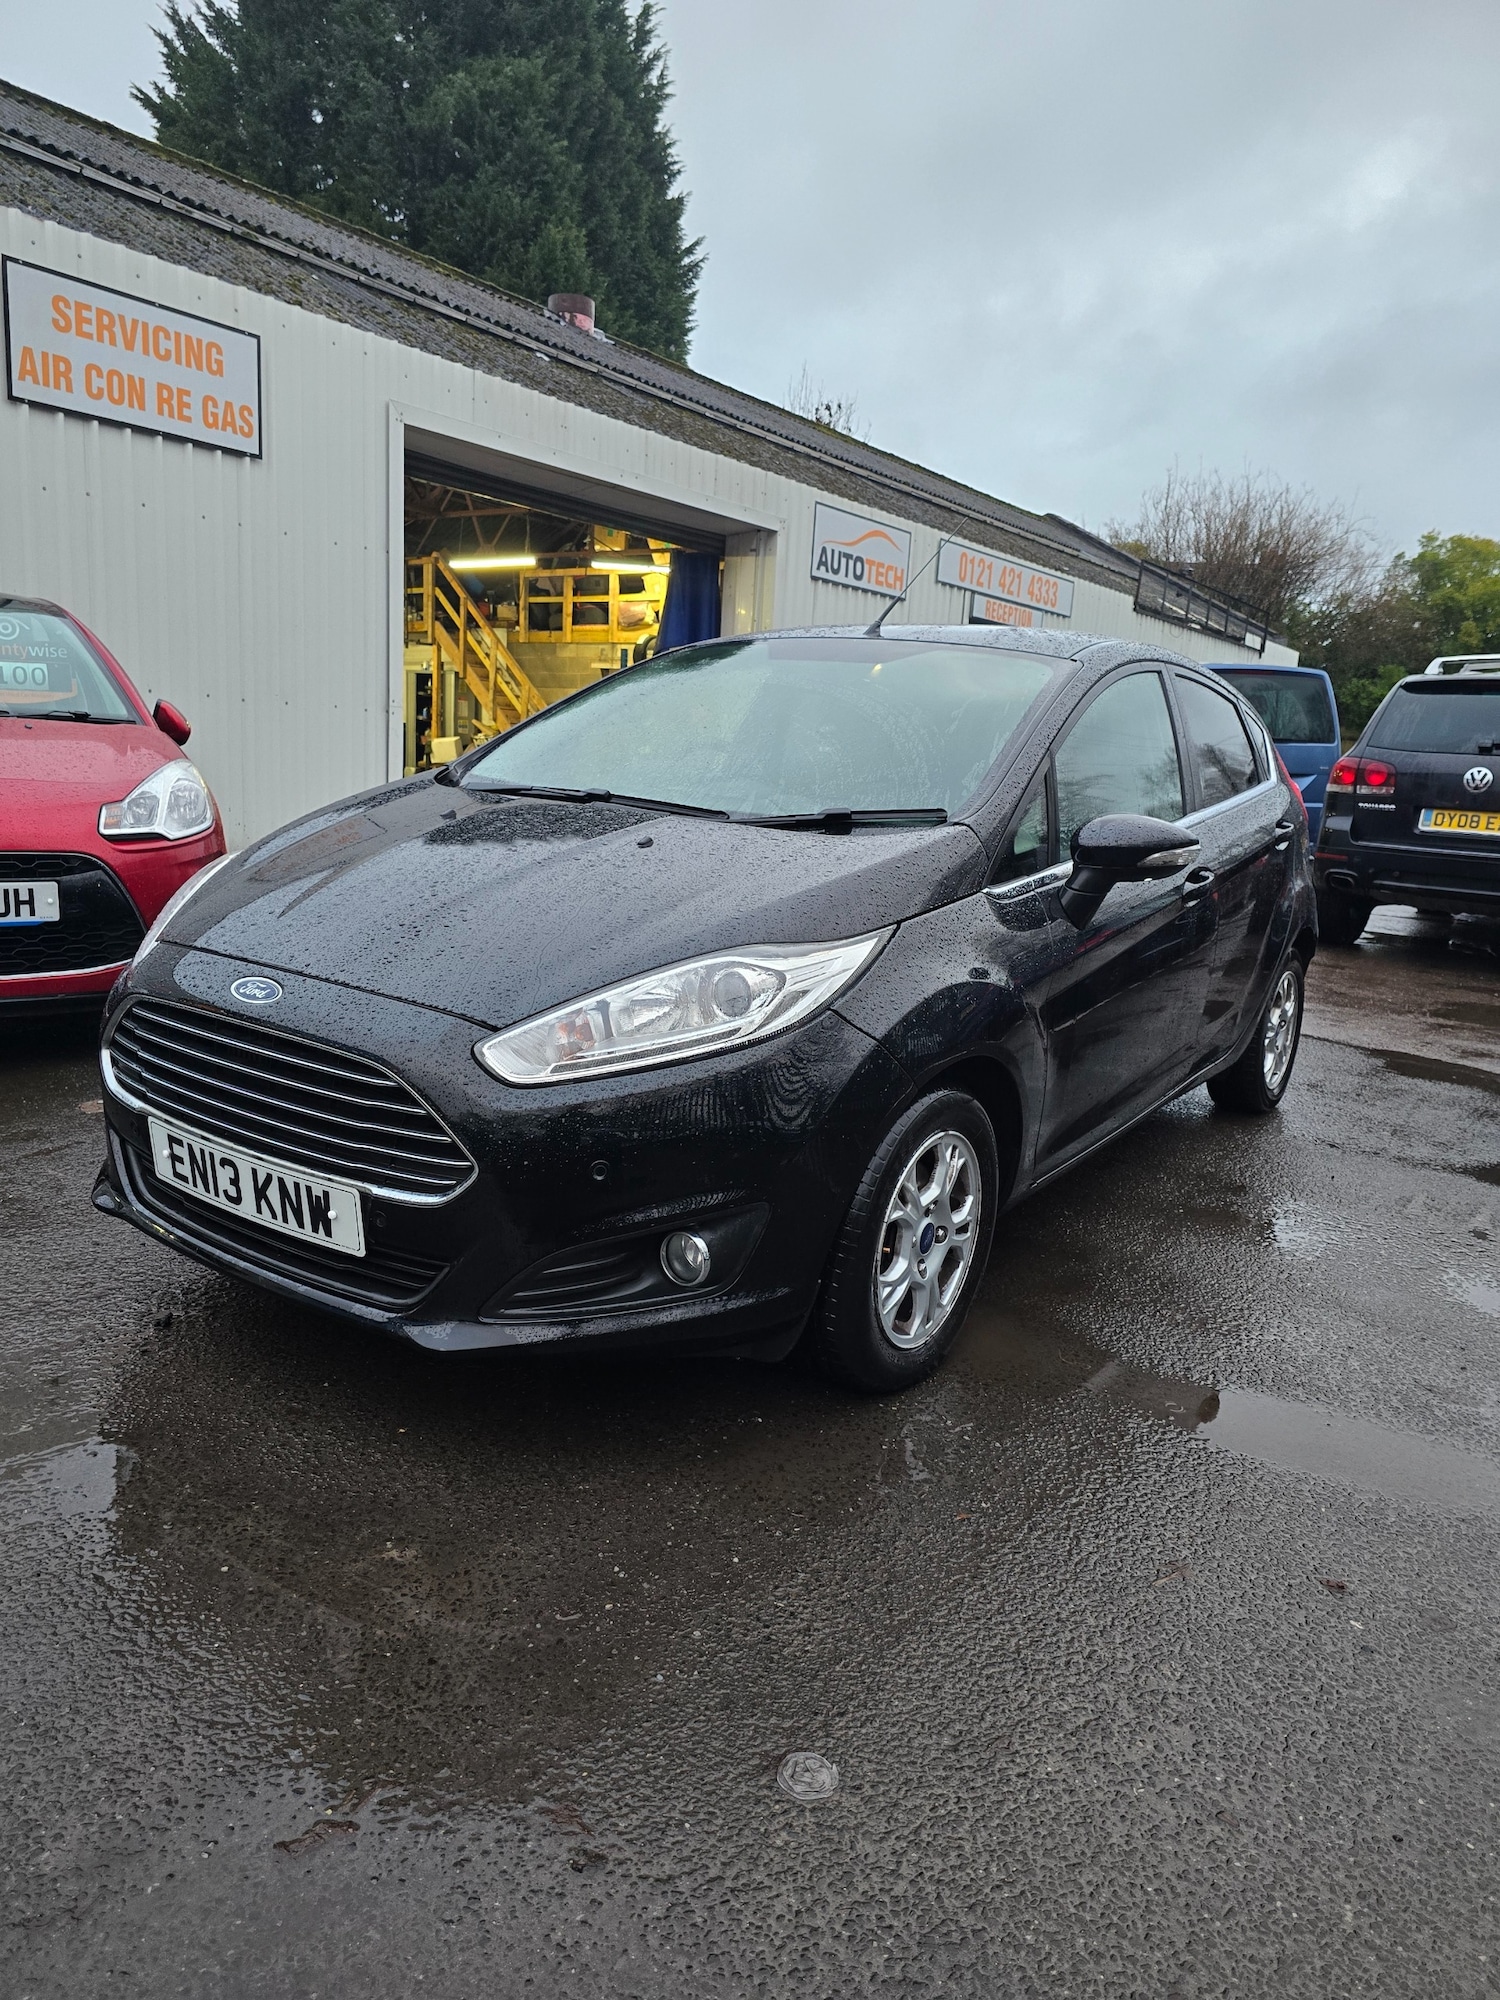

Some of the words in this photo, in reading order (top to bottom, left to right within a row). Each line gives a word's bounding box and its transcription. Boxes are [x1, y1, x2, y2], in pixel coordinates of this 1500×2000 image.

[51, 294, 225, 378] SERVICING
[17, 345, 74, 394] AIR
[84, 362, 146, 412] CON
[156, 381, 193, 424] RE
[202, 394, 254, 439] GAS
[816, 545, 904, 592] AUTOTECH
[958, 551, 993, 590] 0121
[998, 565, 1023, 599] 421
[1027, 574, 1059, 609] 4333
[985, 599, 1033, 627] RECEPTION
[1433, 812, 1481, 829] OY08
[1486, 815, 1500, 831] E
[239, 981, 271, 999] Ford
[166, 1133, 242, 1206] EN13
[251, 1166, 333, 1239] KNW
